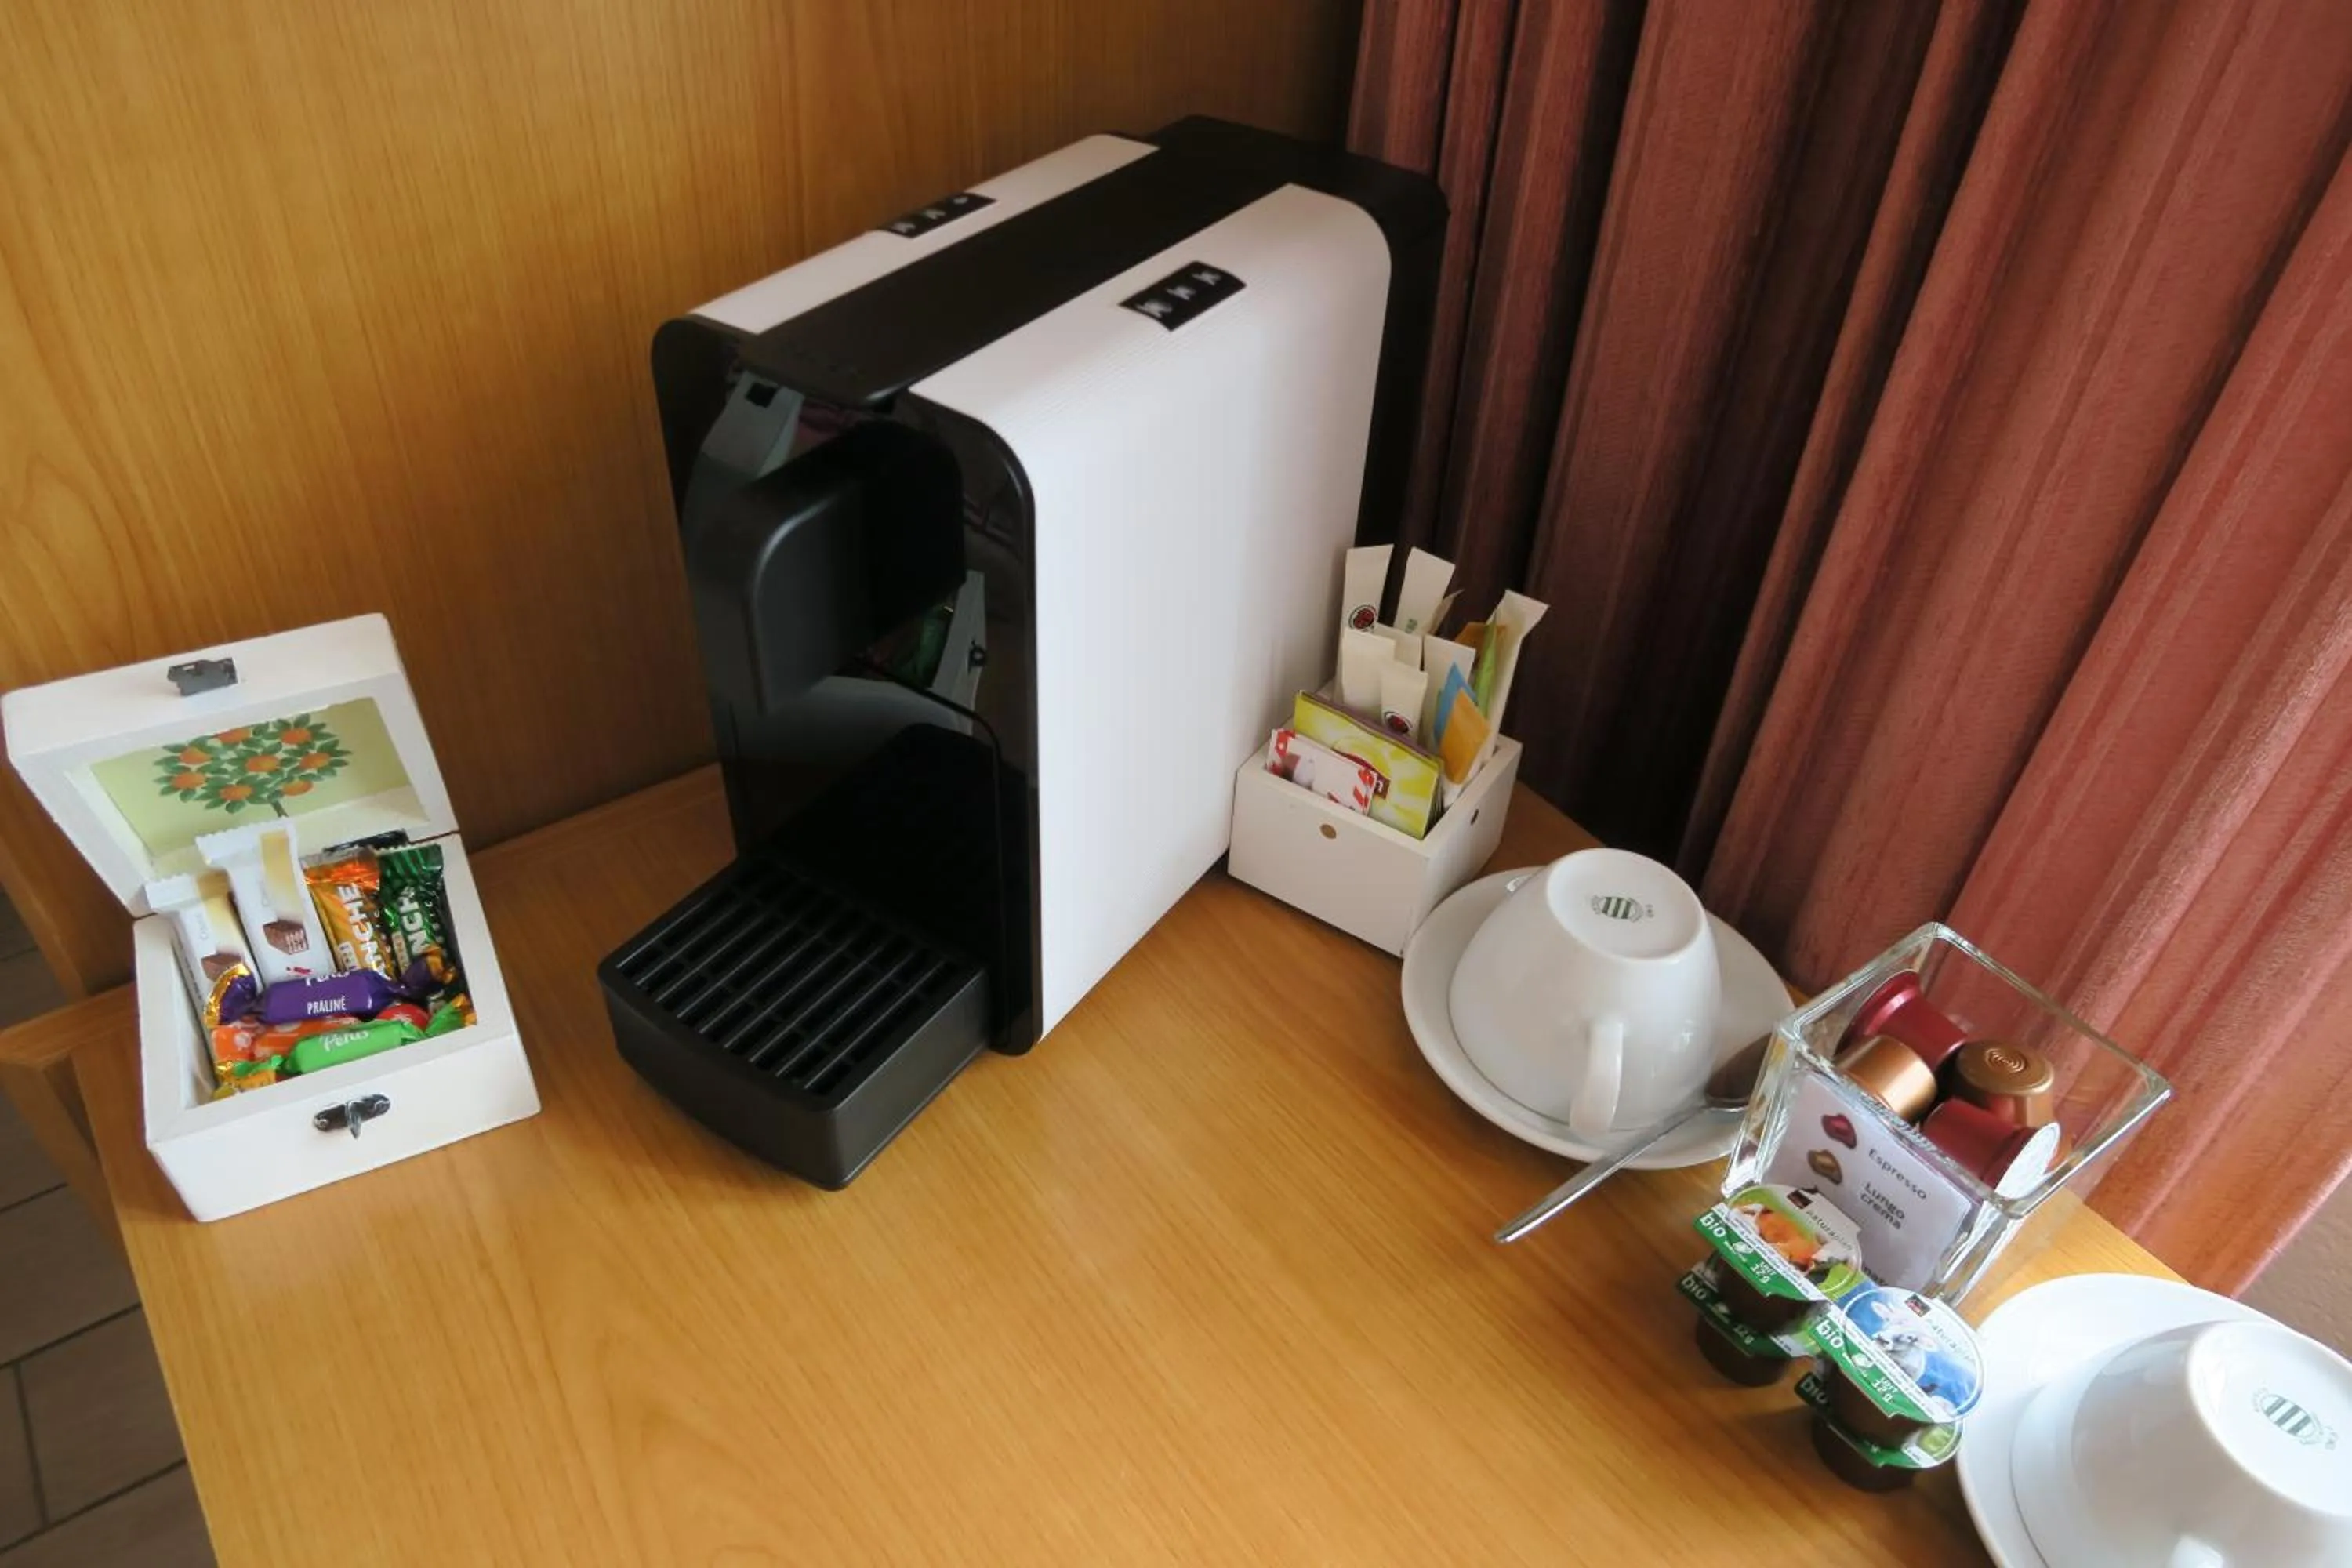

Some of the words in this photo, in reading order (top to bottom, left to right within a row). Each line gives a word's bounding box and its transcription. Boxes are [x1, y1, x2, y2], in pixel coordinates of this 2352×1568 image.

[1700, 1212, 1726, 1238] bio
[1751, 1263, 1766, 1279] 12
[1681, 1274, 1707, 1300] bio
[1815, 1319, 1844, 1349] bio
